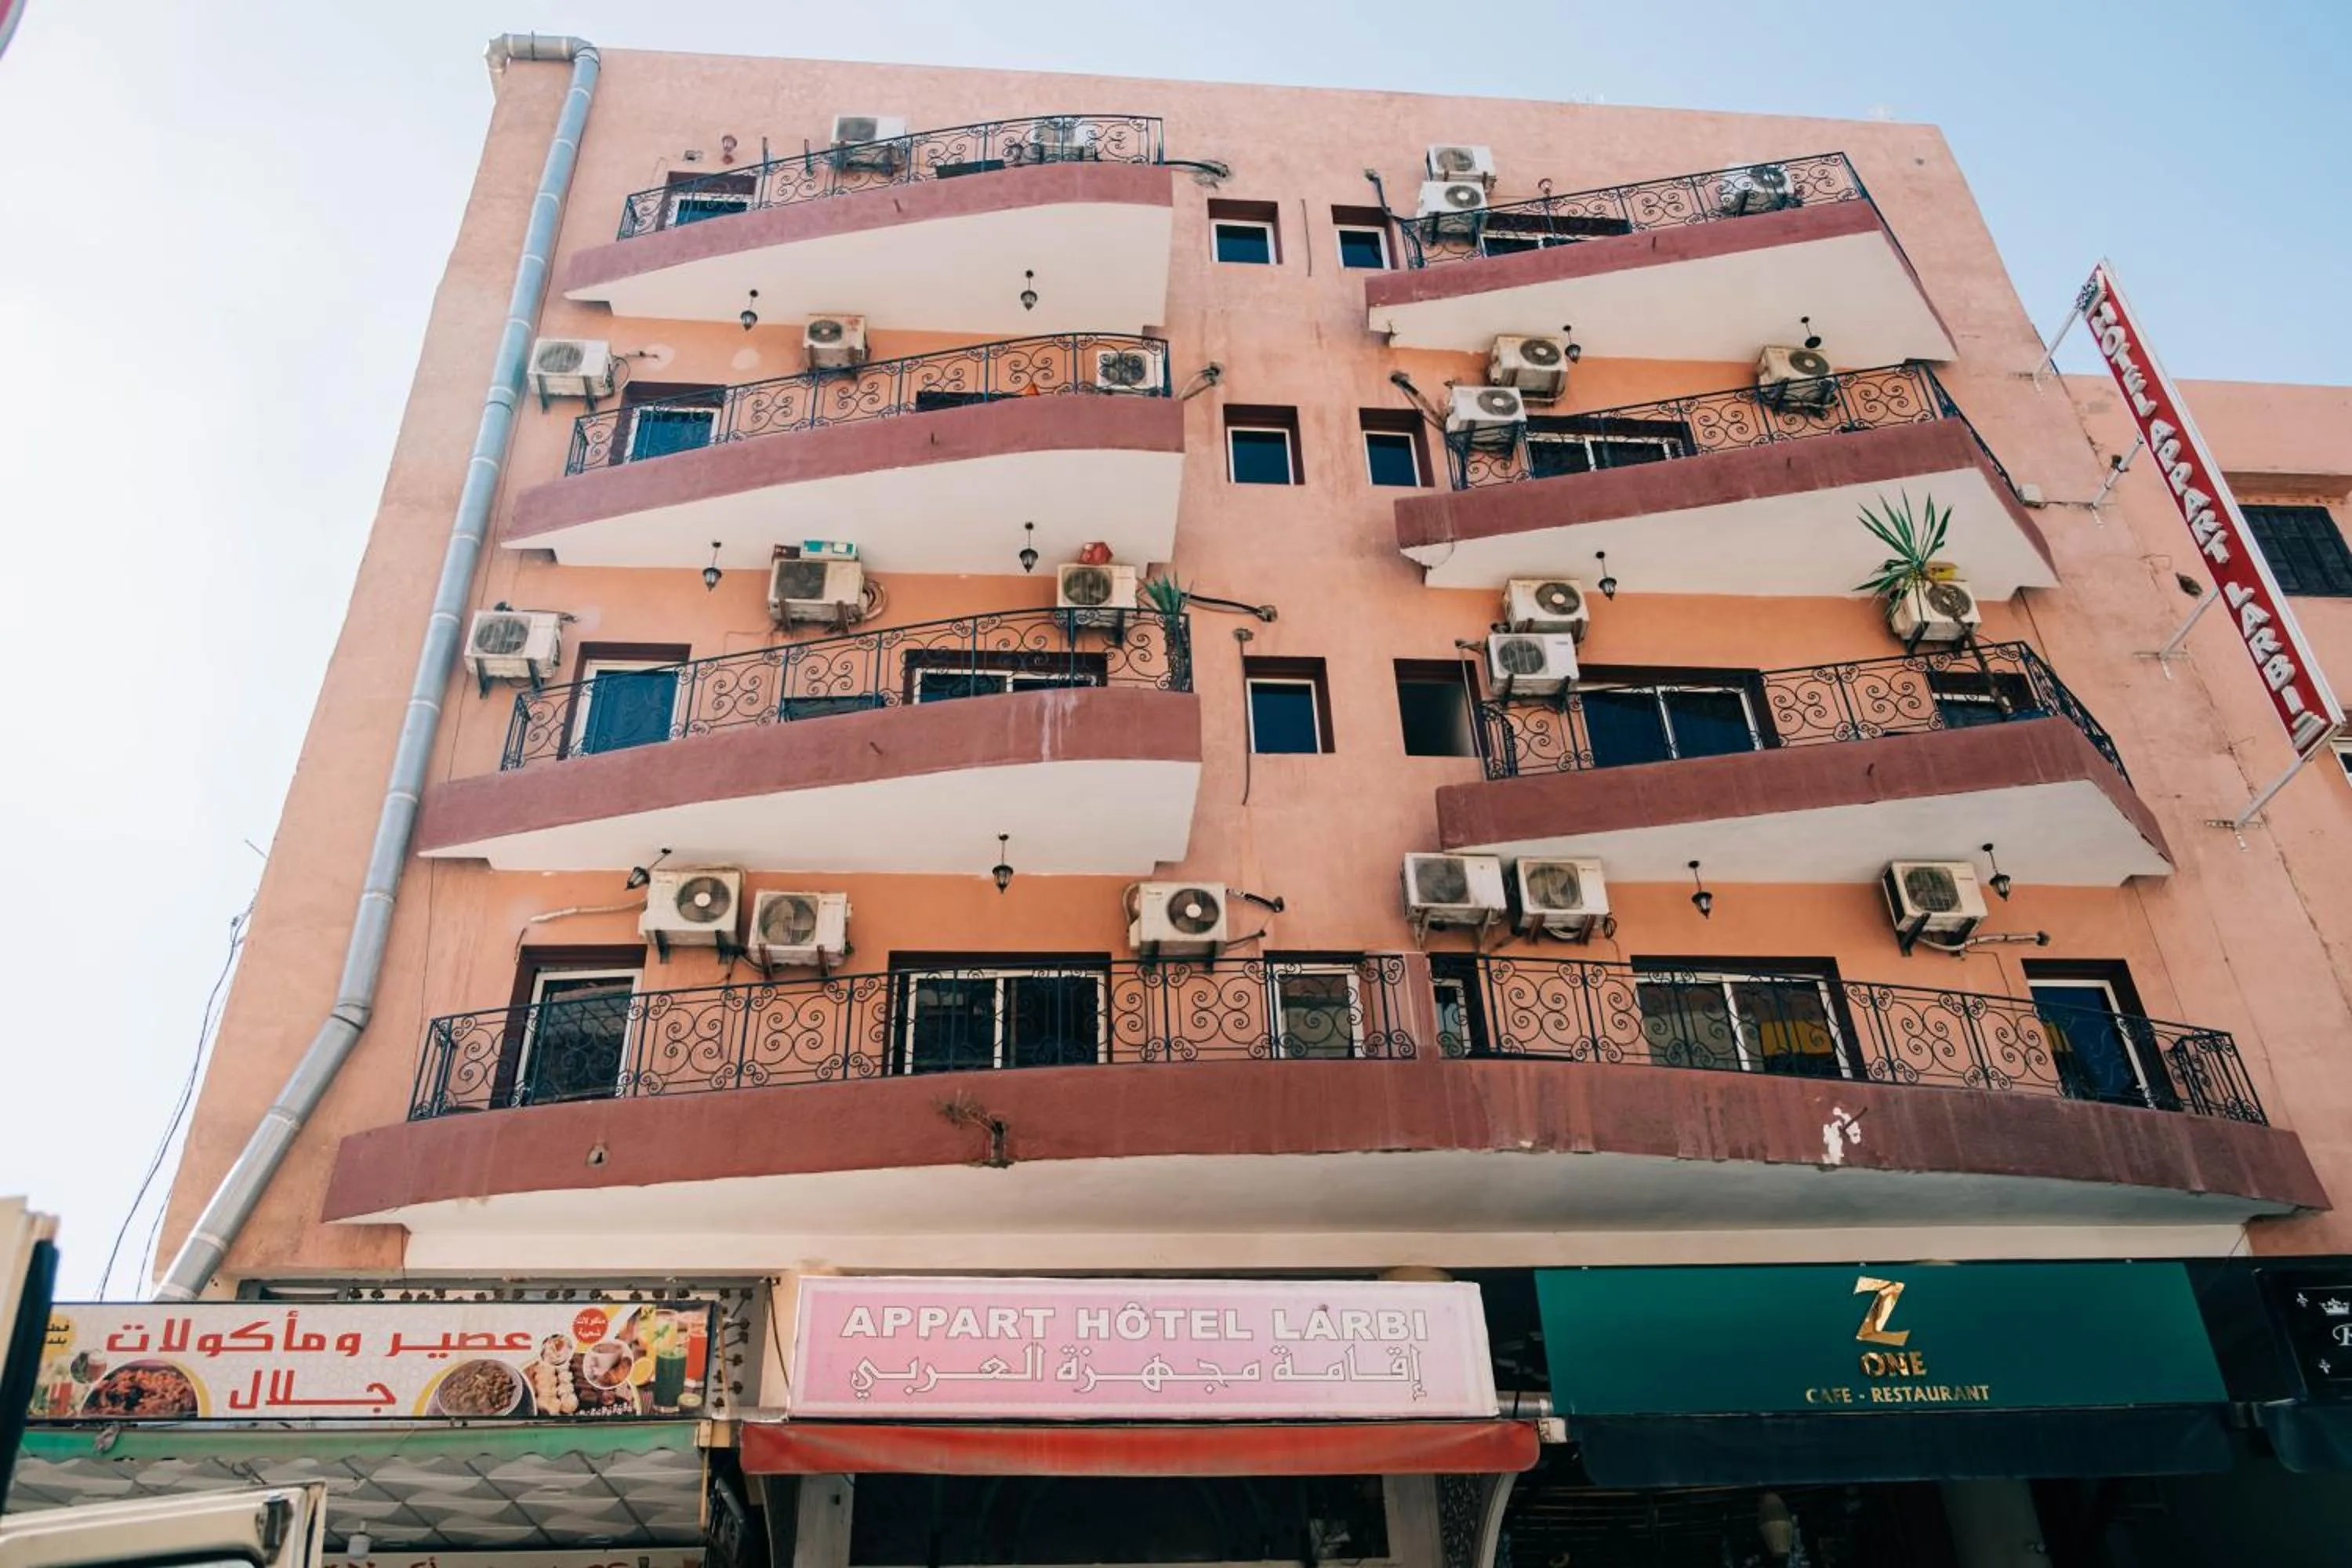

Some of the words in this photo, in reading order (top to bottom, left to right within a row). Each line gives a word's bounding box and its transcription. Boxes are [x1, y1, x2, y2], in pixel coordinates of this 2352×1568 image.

[2090, 301, 2158, 417] HOTEL
[2149, 419, 2230, 564] APPART
[2223, 582, 2304, 715] LARBI
[106, 1309, 362, 1357] ومأكولات
[840, 1305, 1056, 1338] APPART
[1076, 1301, 1254, 1341] HÔTEL
[1272, 1308, 1428, 1341] LARBI
[1853, 1276, 1911, 1347] Z
[383, 1332, 532, 1359] عصير
[1860, 1351, 1928, 1377] ONE
[228, 1369, 396, 1414] جلال
[850, 1341, 1047, 1399] العربي
[1055, 1344, 1261, 1396] مجهزة
[1270, 1343, 1428, 1402] إقامة
[1805, 1387, 1853, 1404] CAFE
[1871, 1384, 1990, 1403] RESTAURANT
